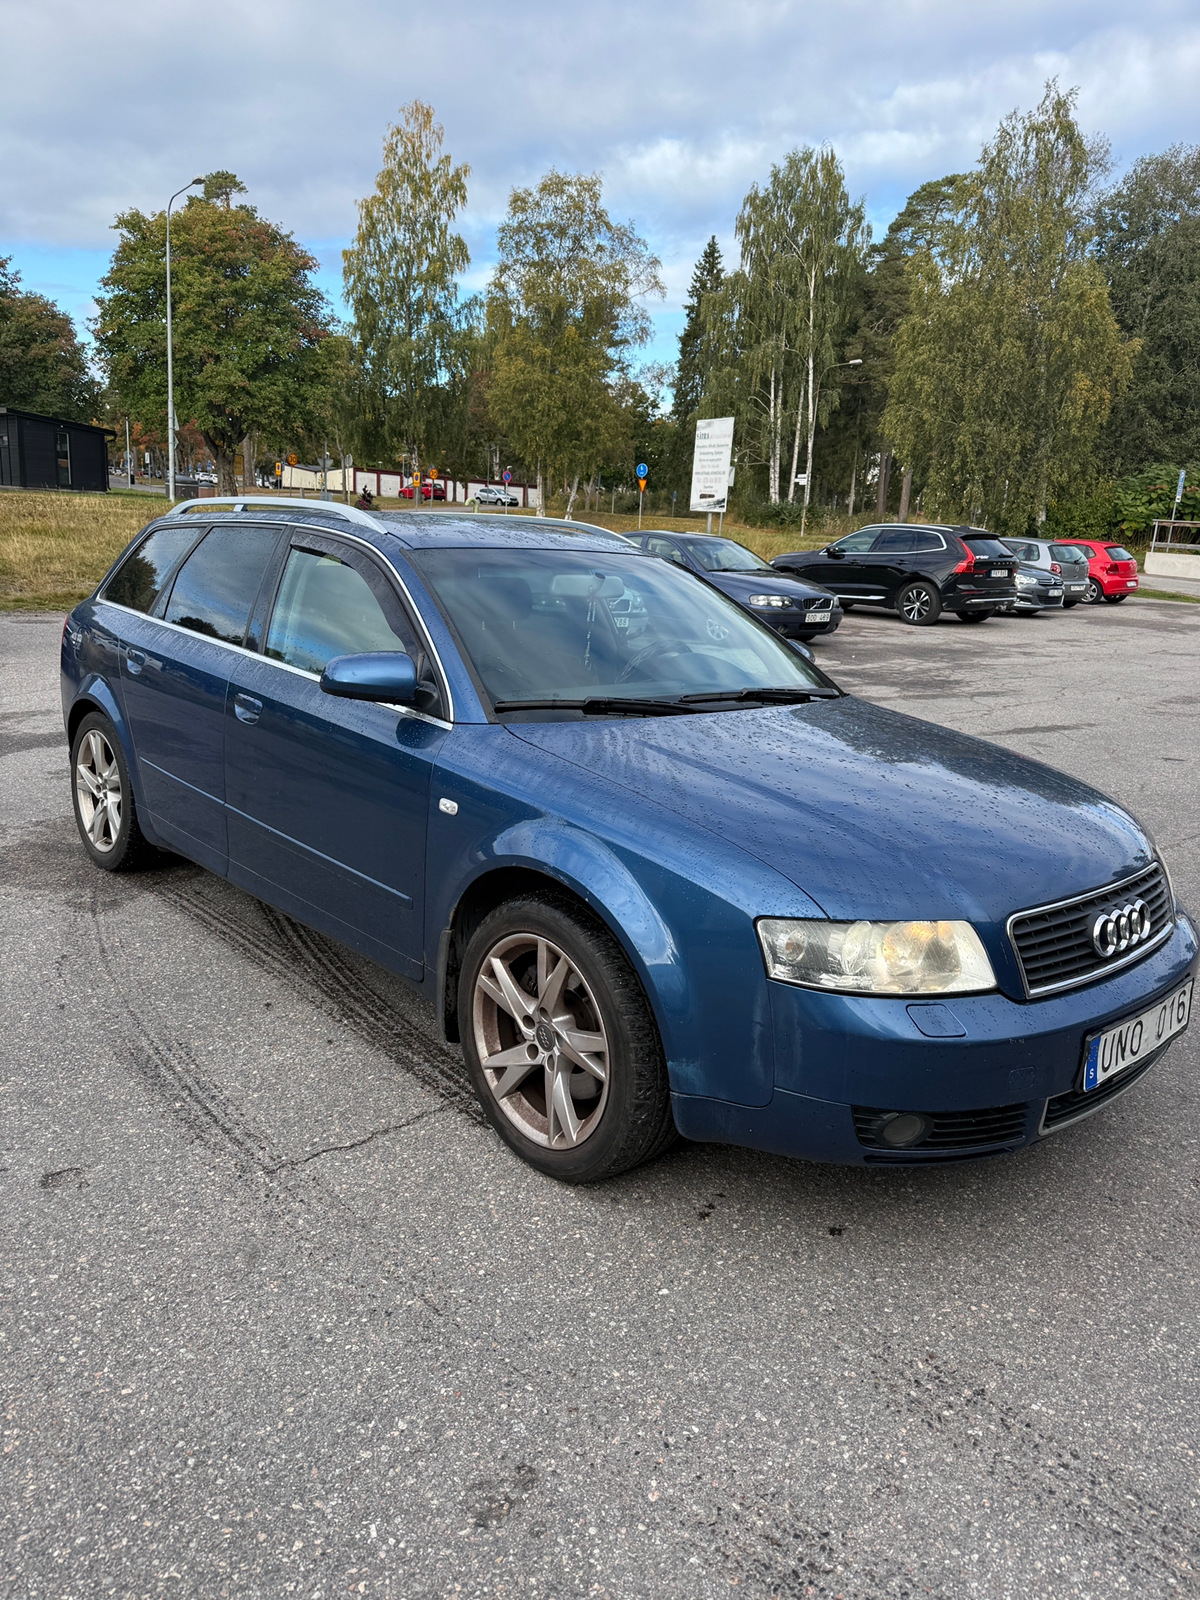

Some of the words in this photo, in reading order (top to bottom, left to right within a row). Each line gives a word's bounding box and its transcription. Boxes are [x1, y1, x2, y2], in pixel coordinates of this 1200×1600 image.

[1101, 1019, 1143, 1073] UNO
[1157, 989, 1187, 1040] 016
[1089, 1068, 1095, 1079] S
